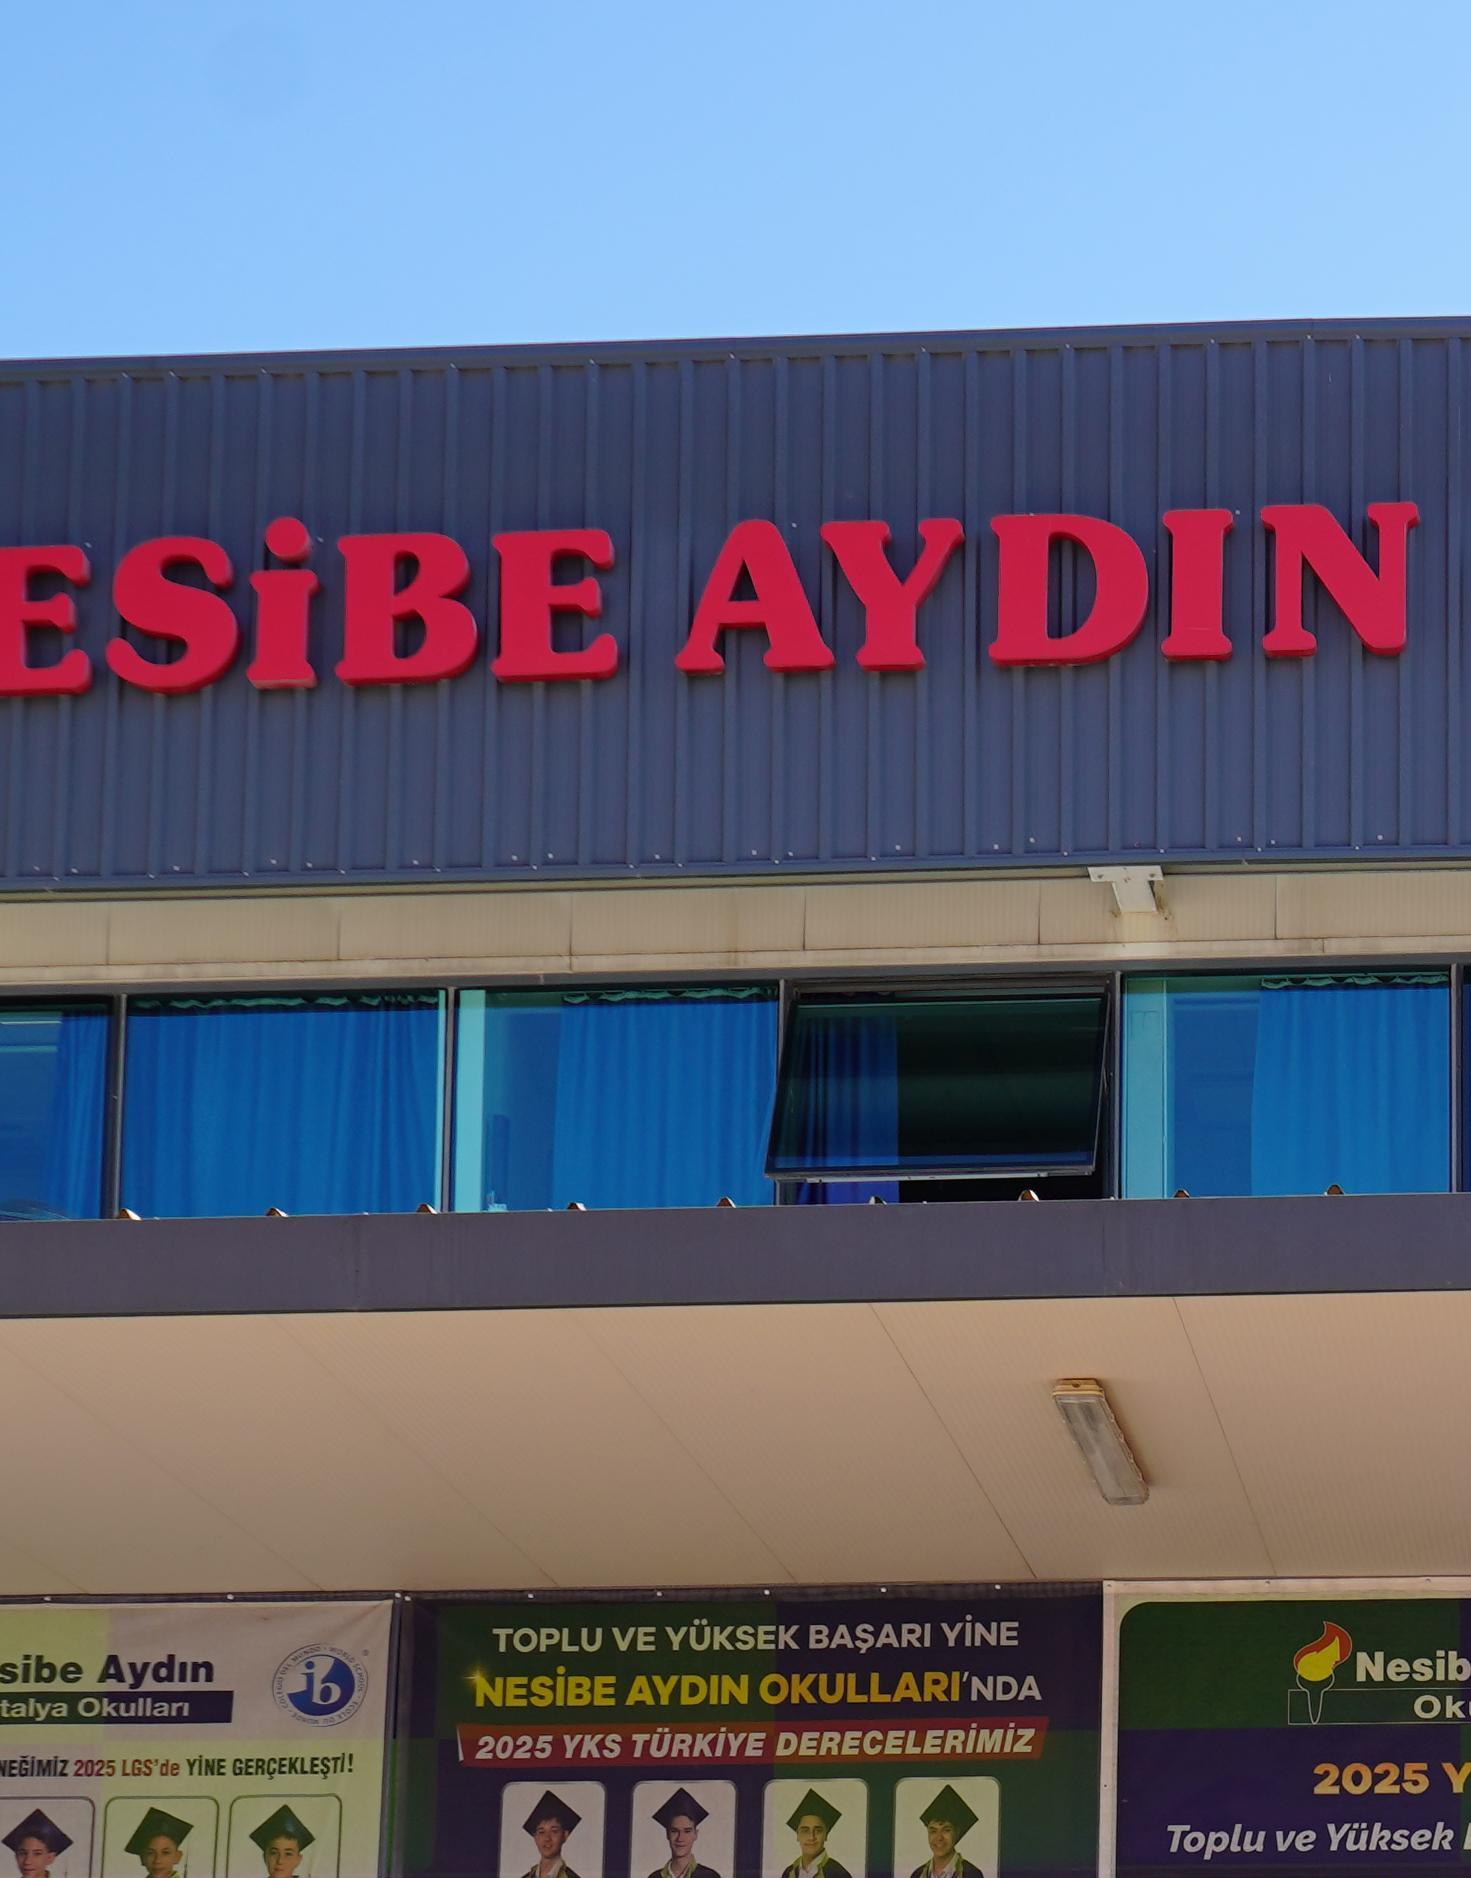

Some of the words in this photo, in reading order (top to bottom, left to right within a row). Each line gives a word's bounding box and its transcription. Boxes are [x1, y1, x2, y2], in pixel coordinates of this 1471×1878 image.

[675, 500, 1421, 676] AYDIN
[492, 1626, 604, 1653] TOPLU
[611, 1626, 657, 1651] VE
[664, 1618, 801, 1651] YÜKSEK
[808, 1622, 932, 1654] BAŞARI
[940, 1613, 1020, 1648] YİNE
[96, 1653, 215, 1690] Aydın
[475, 1665, 618, 1708] NESİBE
[625, 1673, 749, 1707] AYDIN
[758, 1671, 1043, 1705] OKULLARI'NDA
[77, 1696, 190, 1718] Okulları
[474, 1734, 553, 1760] 2025
[562, 1733, 623, 1759] YKS
[631, 1726, 767, 1758] TÜRKİYE
[774, 1722, 1036, 1757] DERECELERİMİZ
[73, 1758, 117, 1778] 2025
[185, 1754, 227, 1777] YİNE
[1313, 1761, 1430, 1795] 2025
[1167, 1823, 1267, 1861] Toplu
[1275, 1829, 1317, 1852] ve
[1326, 1821, 1455, 1853] Yüksek
